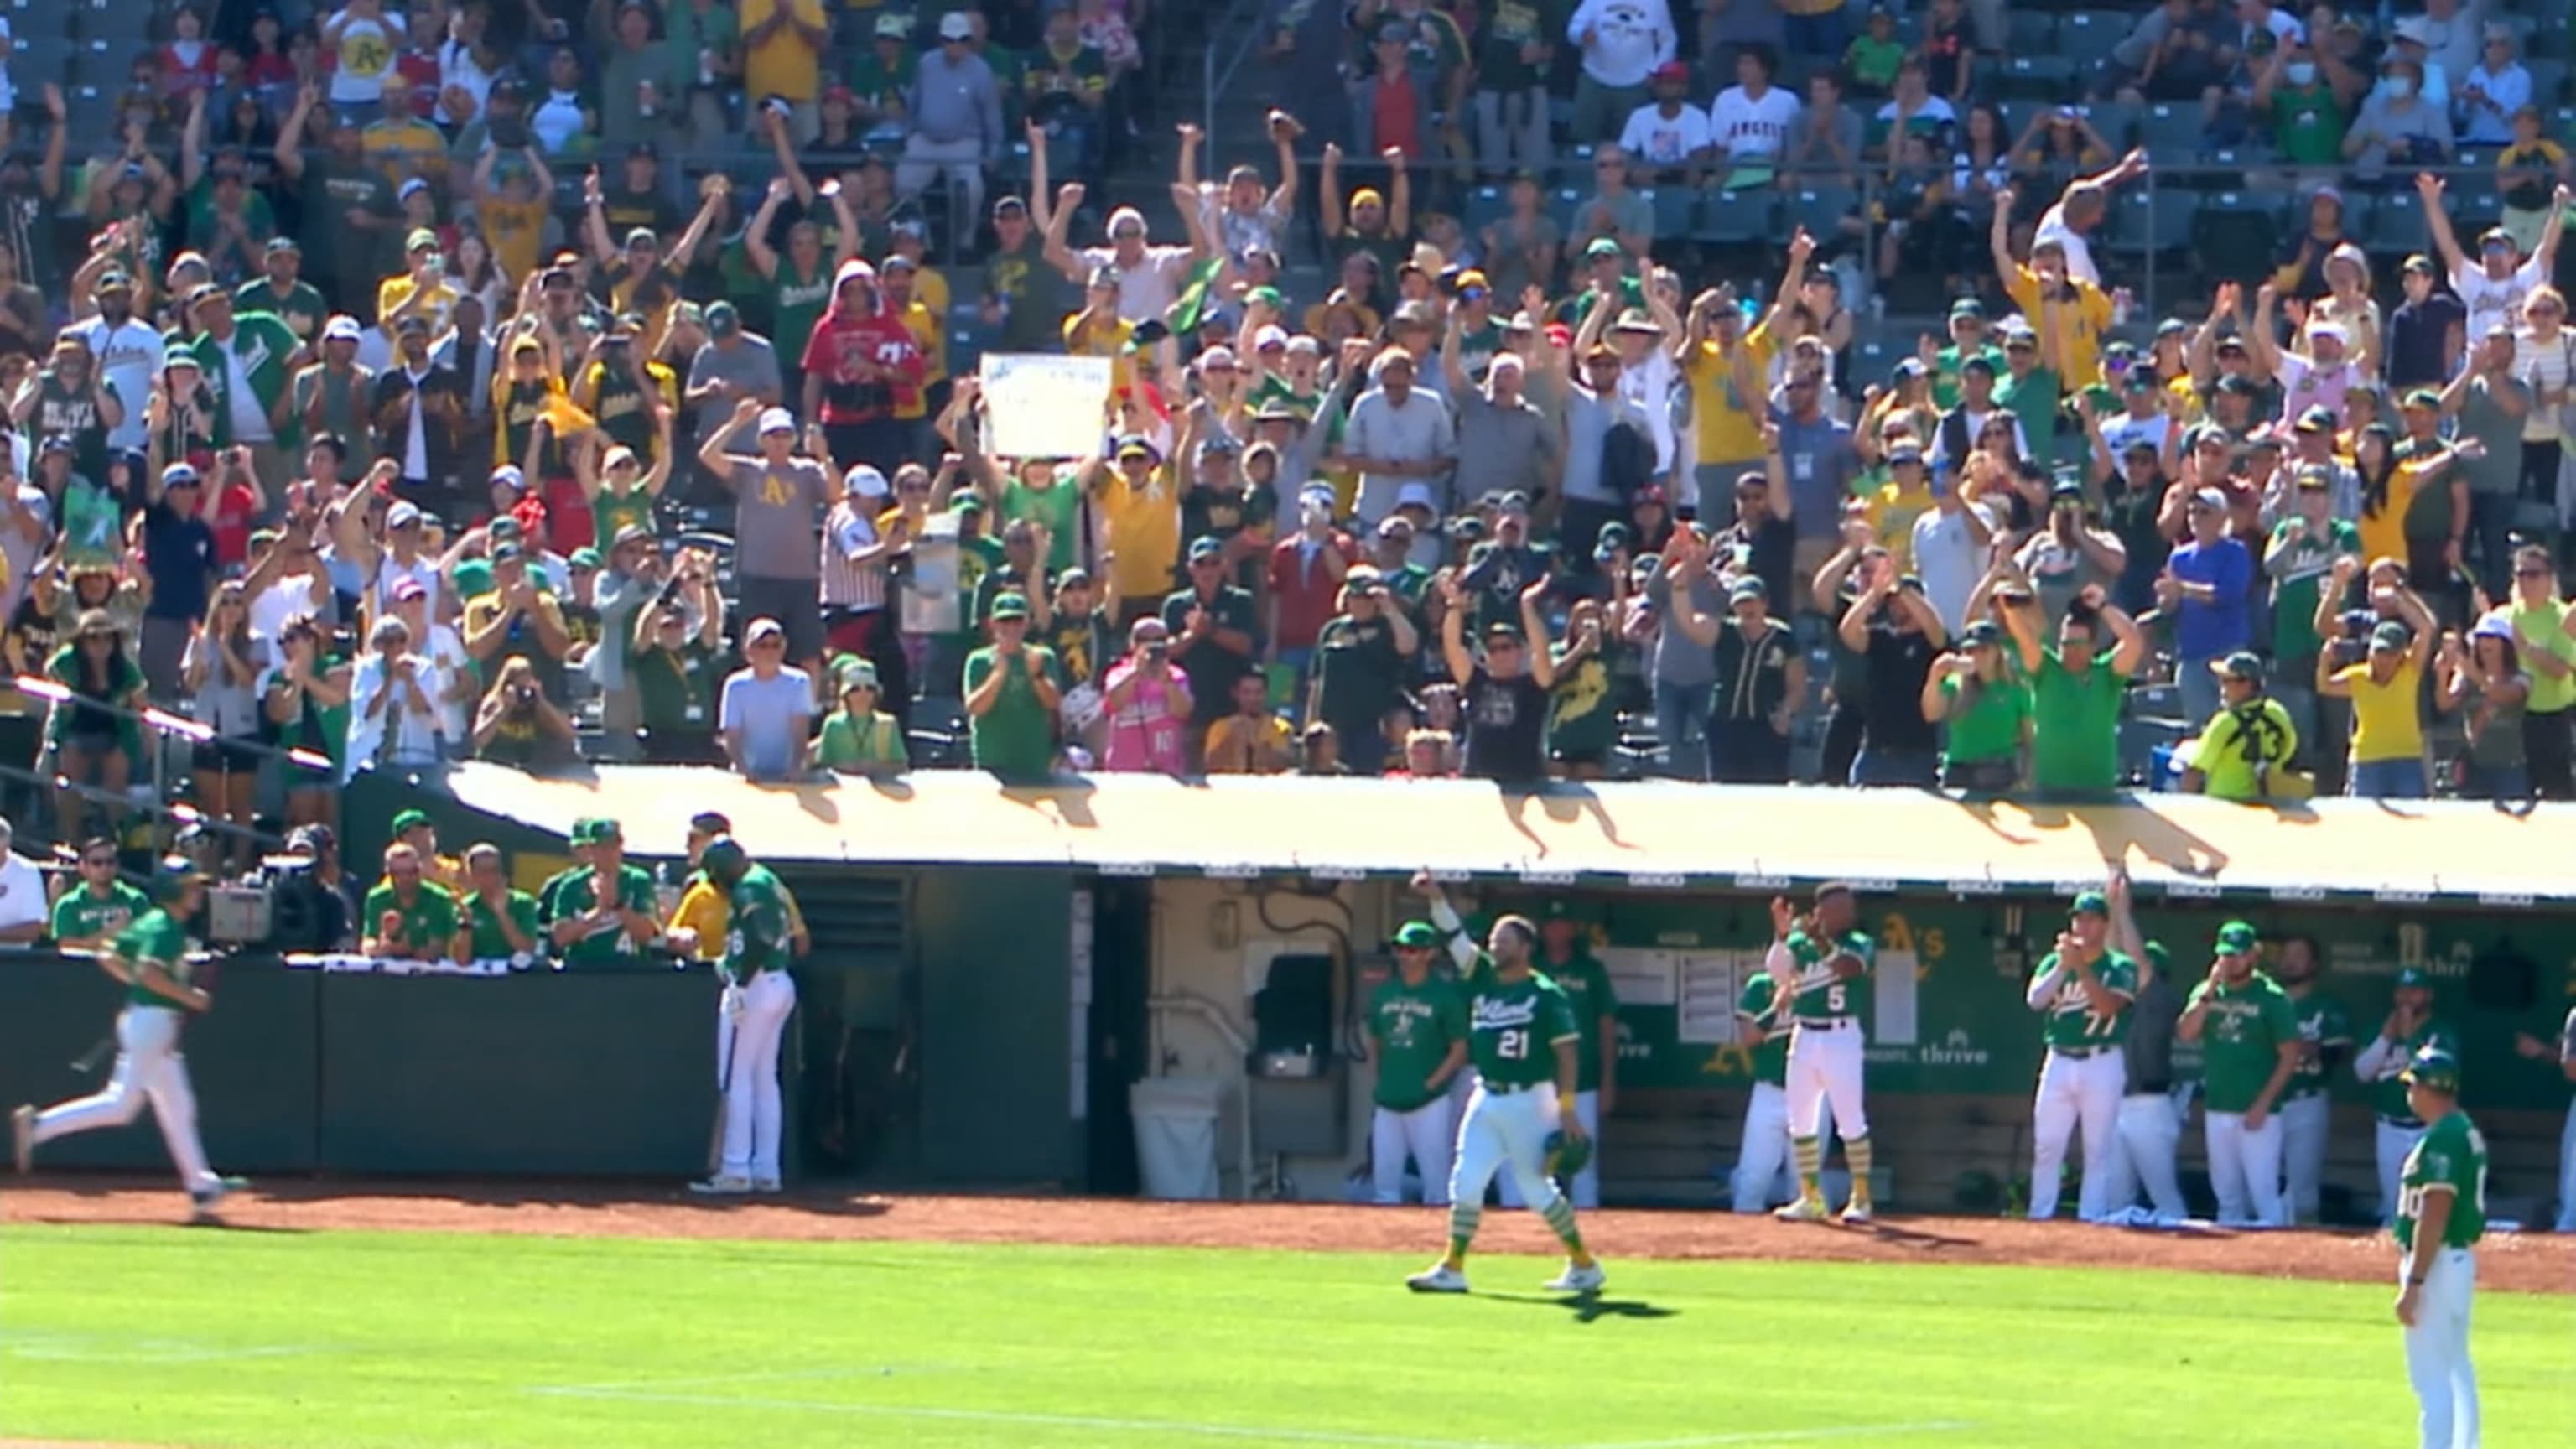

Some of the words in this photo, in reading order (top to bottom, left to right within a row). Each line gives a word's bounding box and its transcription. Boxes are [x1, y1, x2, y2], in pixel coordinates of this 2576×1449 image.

[1828, 985, 1846, 1011] 5
[1498, 1031, 1530, 1059] 21
[1920, 1042, 1987, 1062] thrive
